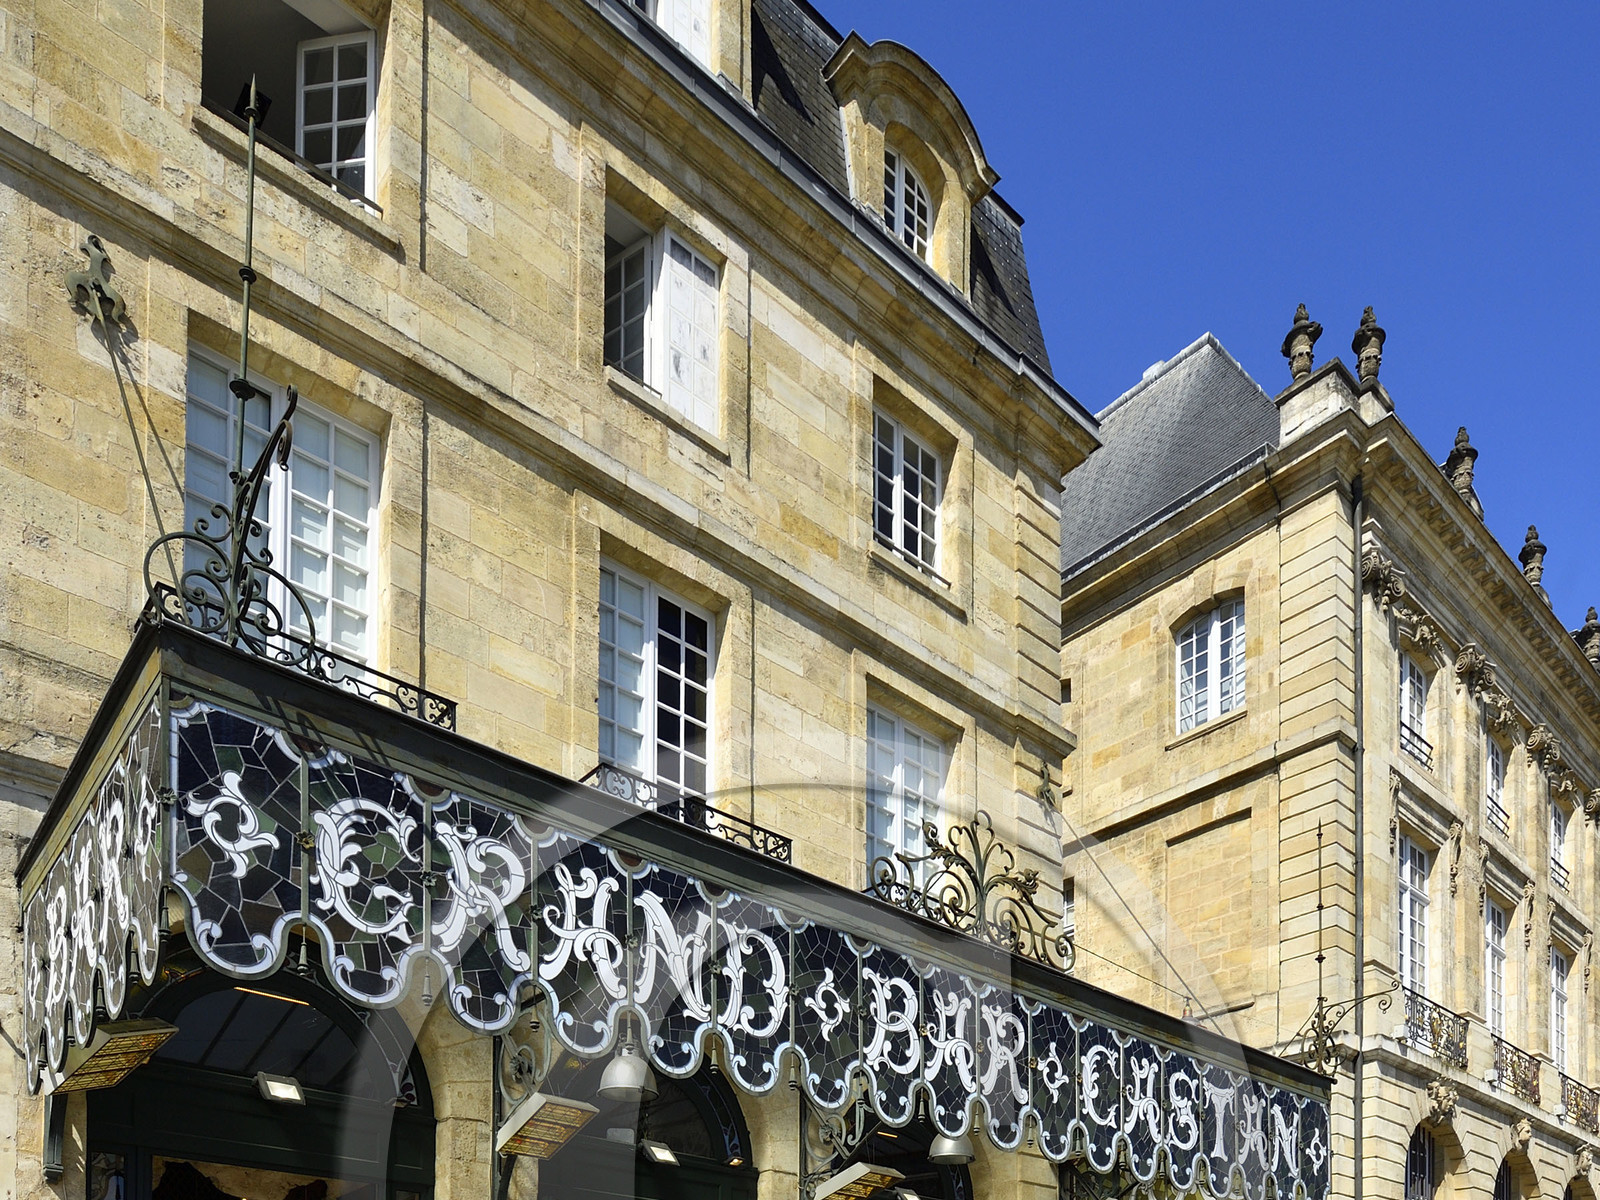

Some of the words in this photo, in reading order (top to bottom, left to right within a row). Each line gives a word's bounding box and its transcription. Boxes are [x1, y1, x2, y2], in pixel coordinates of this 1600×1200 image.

[311, 797, 789, 1038] GRAND
[862, 967, 1029, 1104] BAR
[1081, 1044, 1300, 1178] CASTAN
